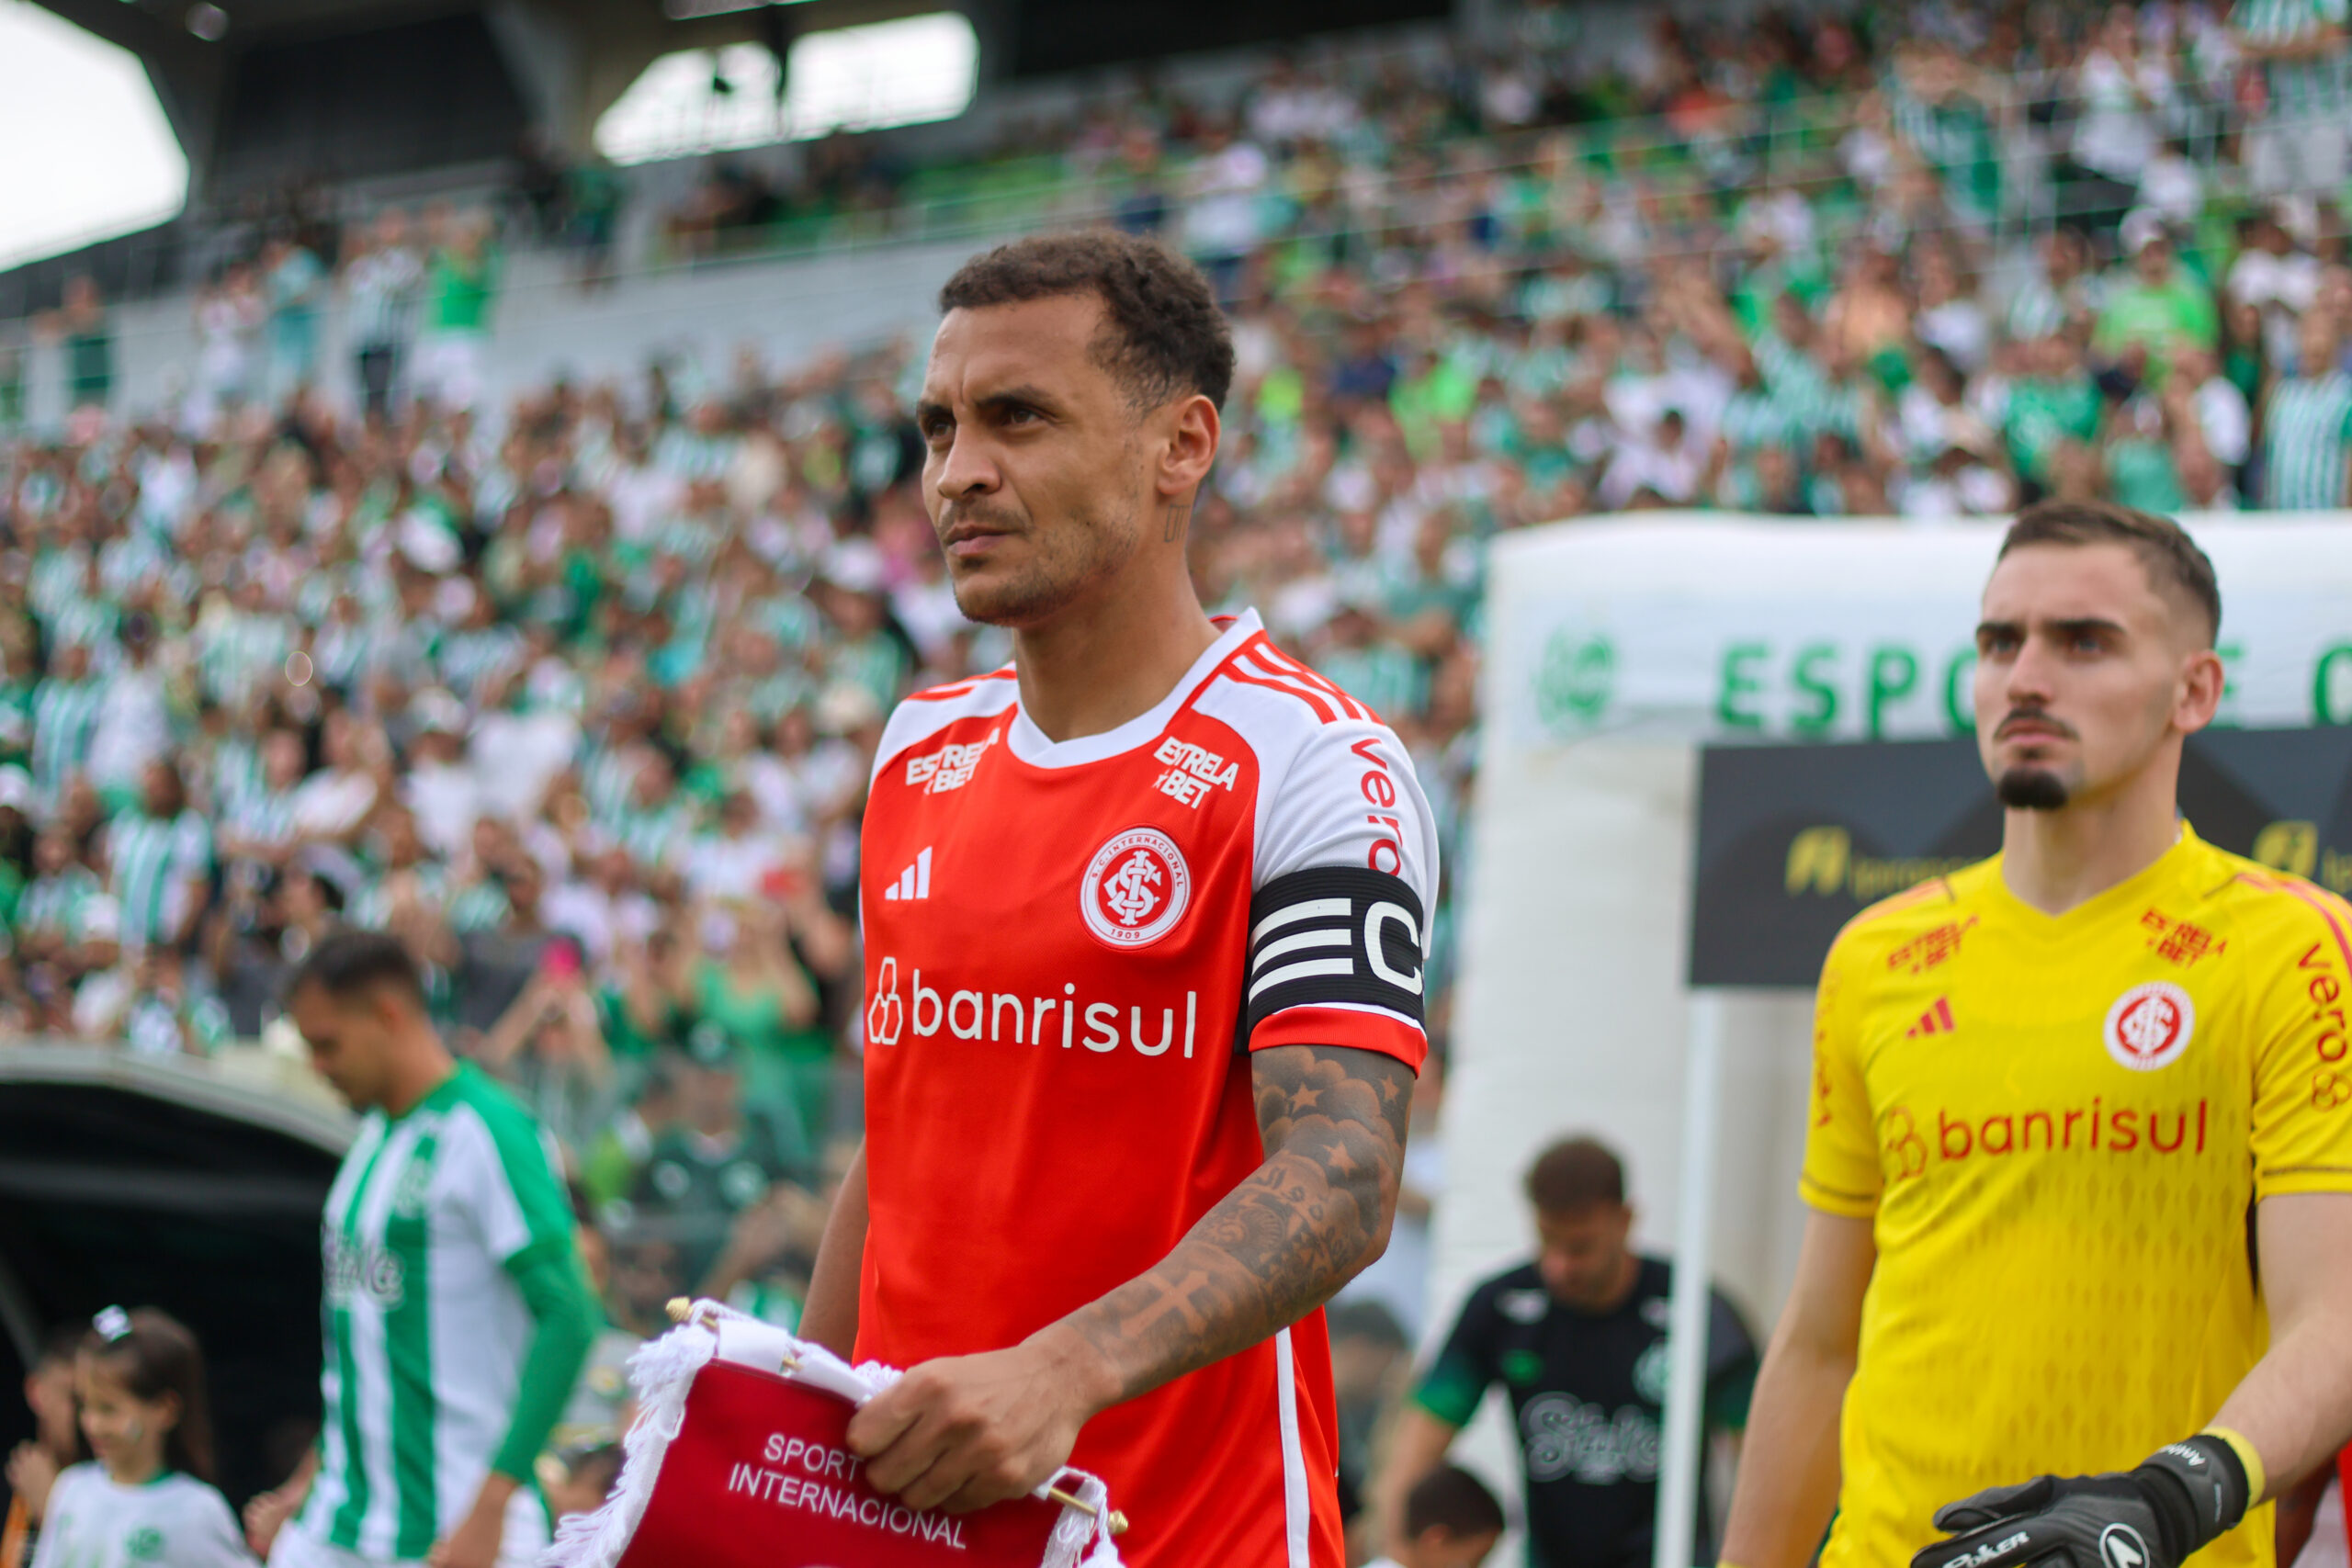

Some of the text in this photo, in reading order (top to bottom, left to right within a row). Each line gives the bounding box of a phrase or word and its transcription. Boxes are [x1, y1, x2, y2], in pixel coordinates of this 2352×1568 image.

[1154, 736, 1239, 792] ESTRELA
[1160, 769, 1213, 809] BET
[1351, 738, 1403, 876] vero
[1108, 836, 1184, 887] INTERNACIONAL
[1111, 929, 1141, 939] 1909
[912, 968, 1196, 1058] banrisul
[2299, 942, 2346, 1062] vero
[1938, 1097, 2207, 1161] banrisul
[764, 1433, 865, 1482] SPORT
[729, 1462, 966, 1550] INTERNACIONAL
